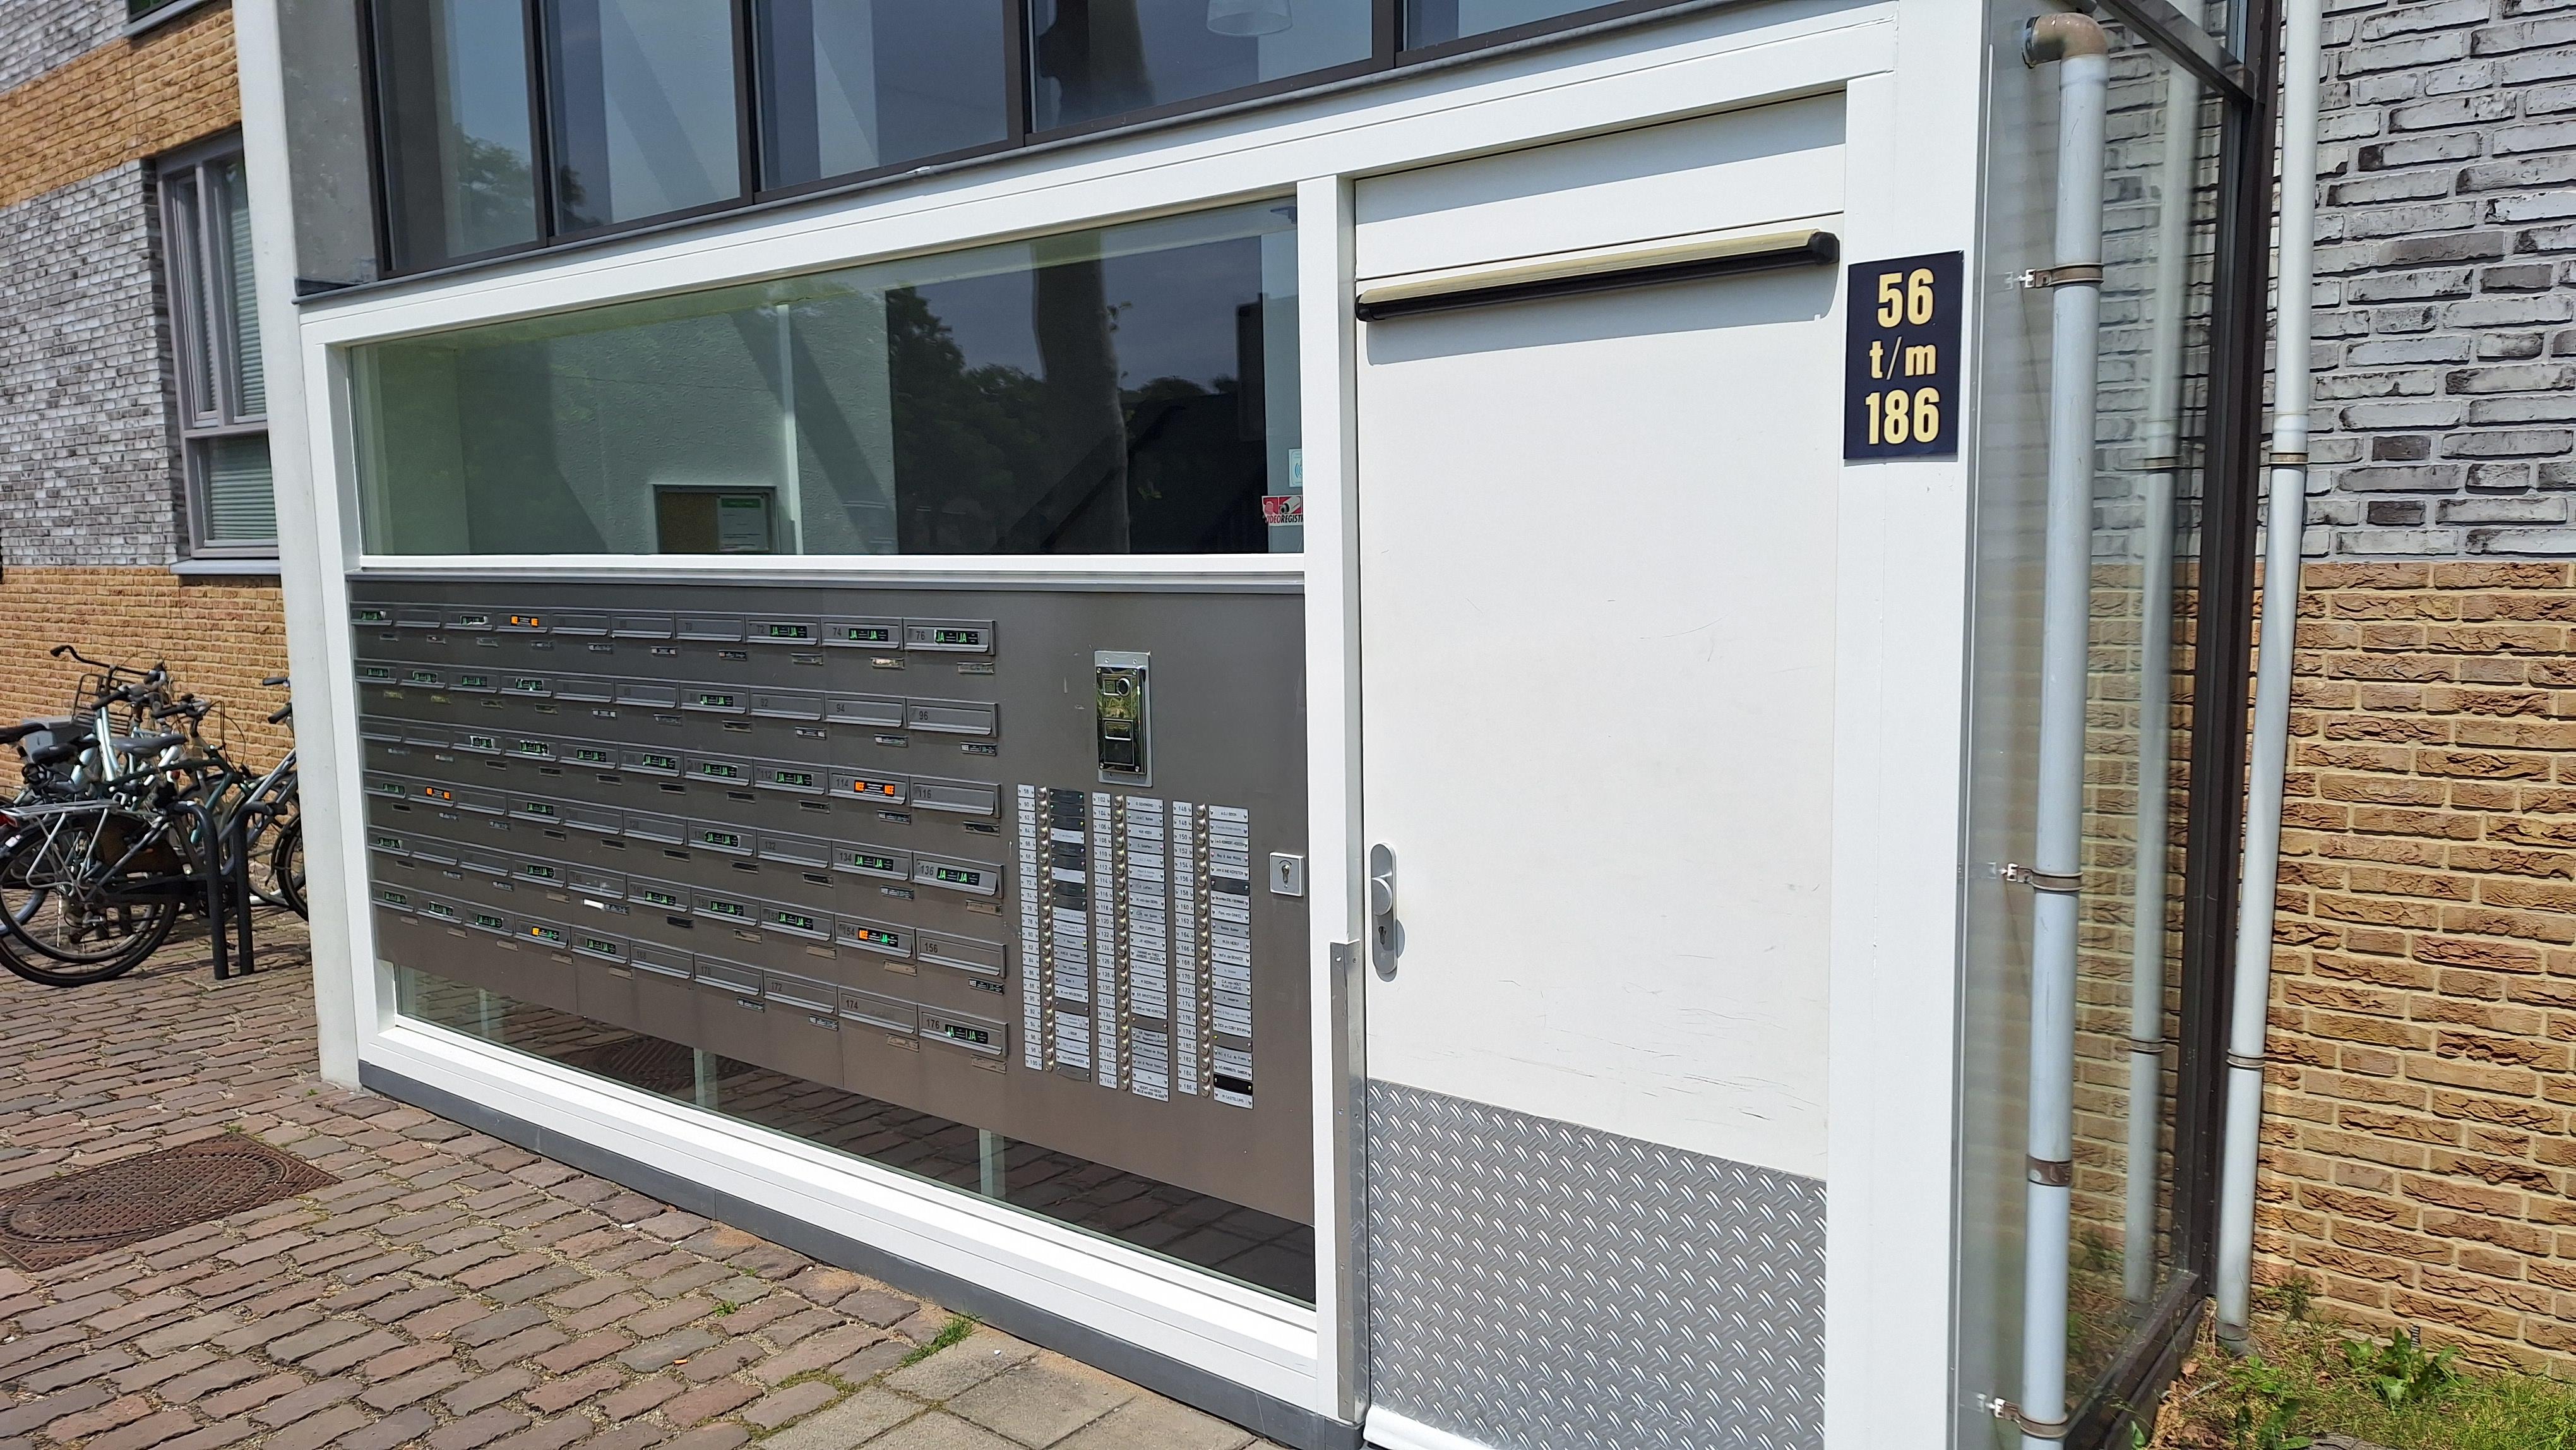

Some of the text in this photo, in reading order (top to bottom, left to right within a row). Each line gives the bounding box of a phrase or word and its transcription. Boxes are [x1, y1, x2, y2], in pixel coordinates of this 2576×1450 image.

[1877, 268, 1934, 328] 56
[1869, 336, 1936, 380] t/m
[1865, 387, 1940, 444] 186
[772, 626, 797, 636] JA JA
[833, 628, 841, 636] 74
[850, 630, 877, 639] JA JA
[916, 631, 924, 640] 76
[936, 632, 967, 642] JA JA
[919, 711, 928, 720] 96
[704, 765, 728, 776] JA JA
[778, 774, 803, 784] JA JA
[837, 779, 849, 787] 114
[919, 789, 931, 798] 116
[707, 833, 730, 844] JA JA
[765, 841, 775, 850] 132
[856, 856, 883, 868] JA JA
[921, 865, 934, 875] 136
[938, 870, 967, 882] JA JA
[712, 902, 735, 914] JA JA
[779, 913, 804, 926] JA JA
[844, 926, 855, 936] 154
[881, 934, 888, 943] JA
[925, 942, 938, 953] 156
[772, 982, 782, 992] 172
[846, 1000, 859, 1010] 174
[926, 1018, 939, 1029] 176
[948, 1027, 975, 1040] JA JA
